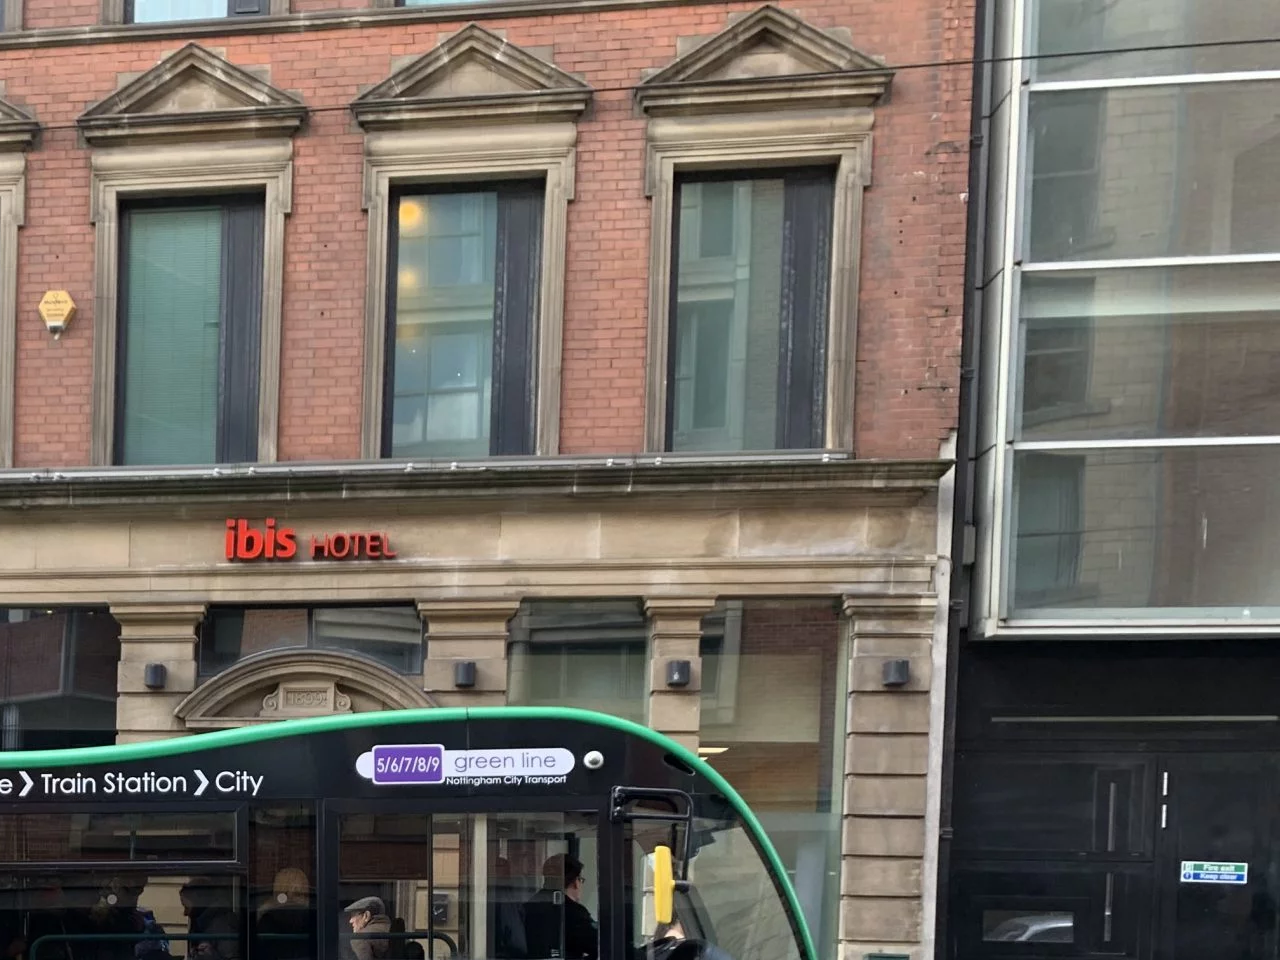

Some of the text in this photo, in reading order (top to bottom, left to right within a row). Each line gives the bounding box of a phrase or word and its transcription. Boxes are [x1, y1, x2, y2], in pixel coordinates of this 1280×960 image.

[225, 517, 397, 560] ibis HOTEL
[376, 756, 440, 774] 5/6/7/8/9
[454, 752, 557, 773] green line
[40, 772, 96, 794] Train
[102, 770, 188, 794] Station
[214, 769, 264, 796] City
[446, 774, 567, 787] Nottingham City Transport
